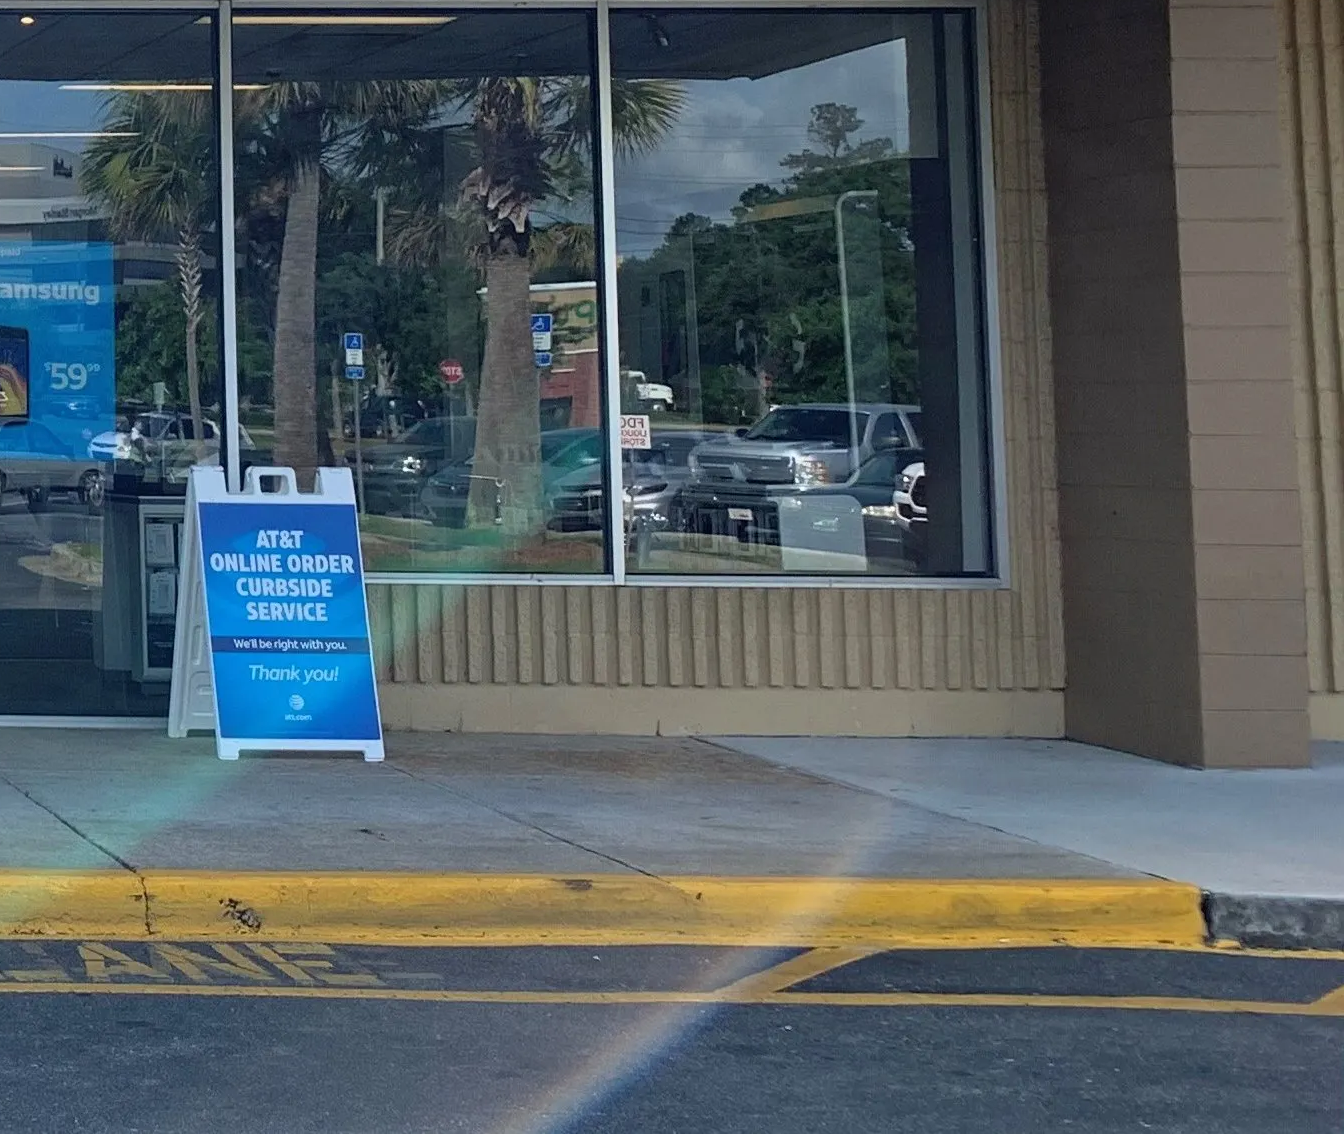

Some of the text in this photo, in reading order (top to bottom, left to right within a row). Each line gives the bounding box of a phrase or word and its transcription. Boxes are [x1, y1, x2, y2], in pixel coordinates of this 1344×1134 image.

[255, 529, 304, 549] AT&T
[210, 553, 355, 574] ONLINE ORDER
[235, 577, 334, 598] CURBSIDE
[246, 601, 329, 622] SERVICE
[233, 638, 347, 652] We'll be right with you.
[249, 664, 339, 685] Thank you!
